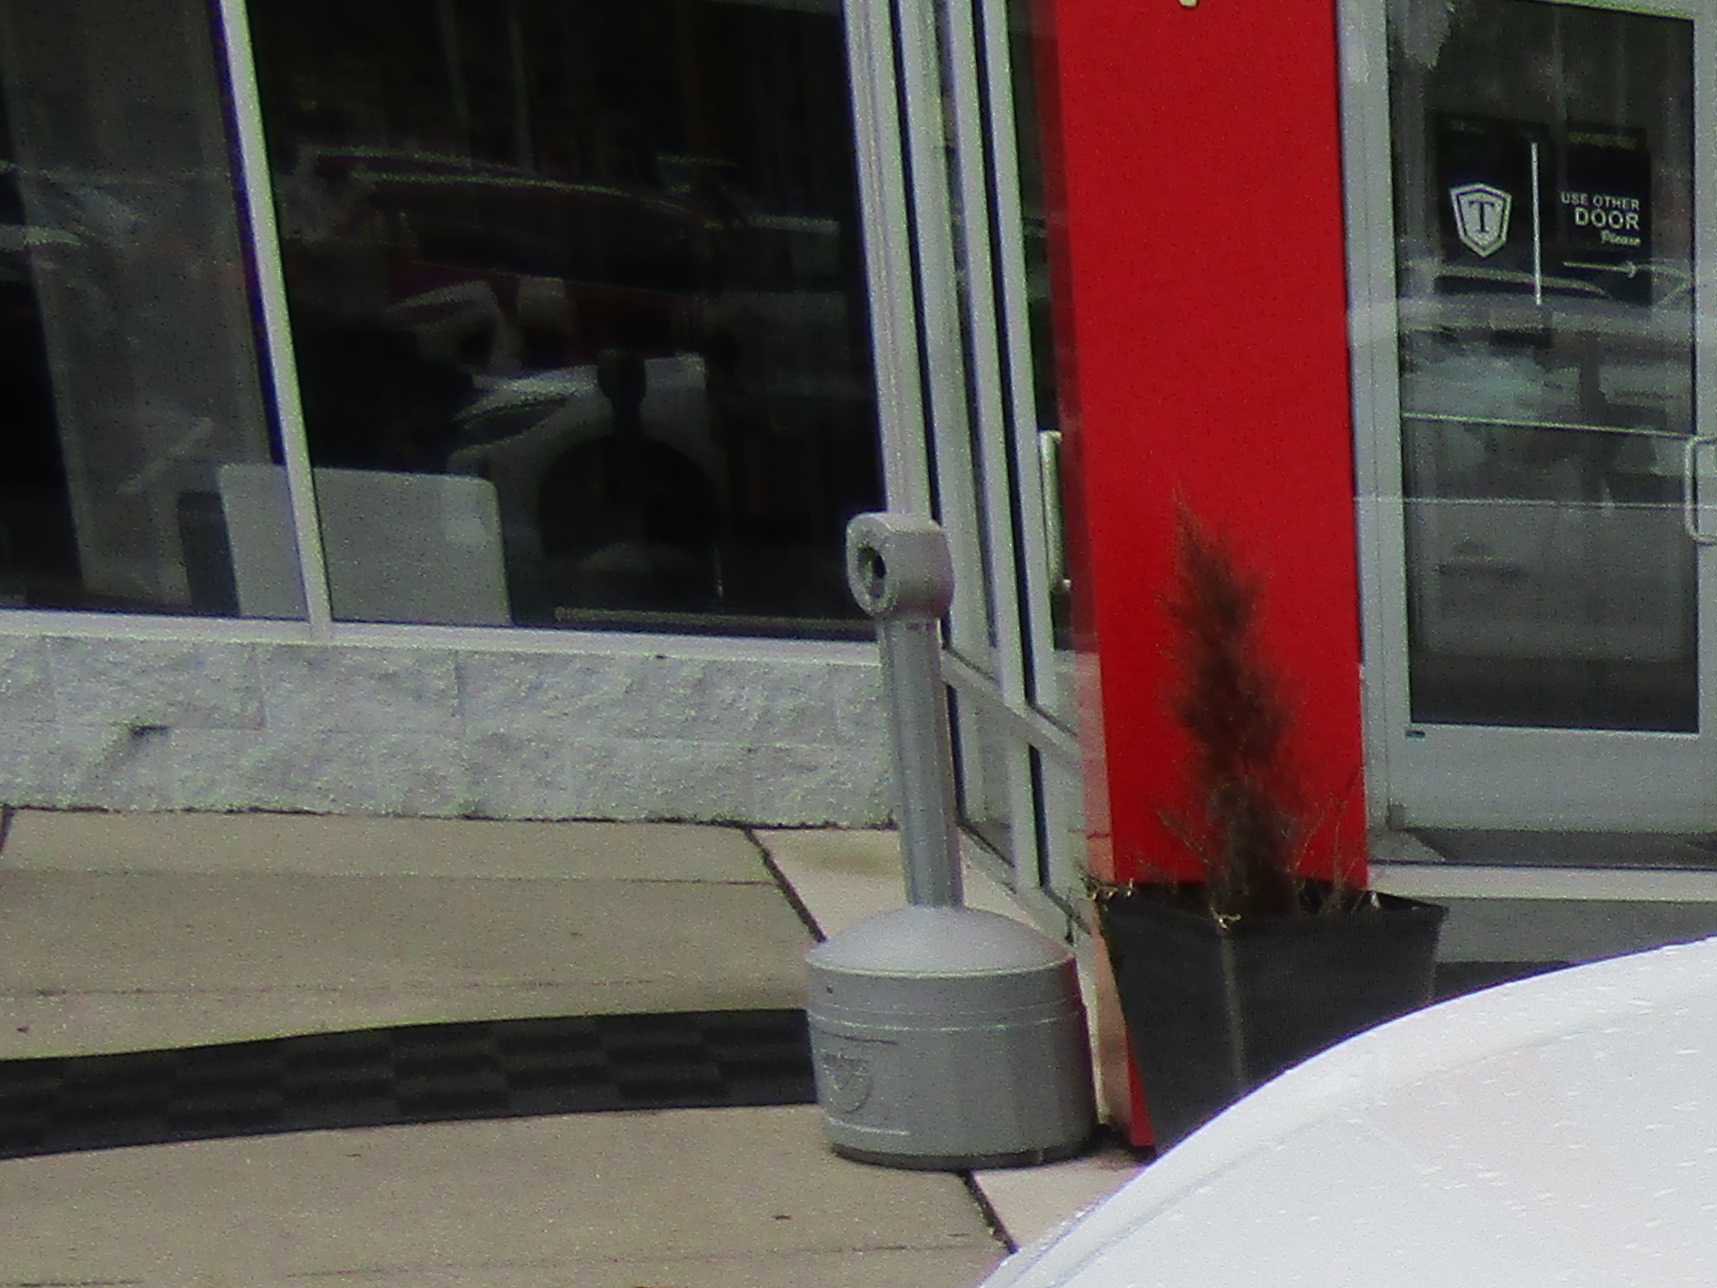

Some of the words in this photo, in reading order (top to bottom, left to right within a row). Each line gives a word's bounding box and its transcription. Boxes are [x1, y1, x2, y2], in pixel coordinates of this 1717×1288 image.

[1561, 191, 1588, 206] USE
[1592, 194, 1640, 211] OTHER
[1468, 199, 1496, 234] T
[1575, 207, 1640, 230] DOOR
[1601, 230, 1641, 246] Please
